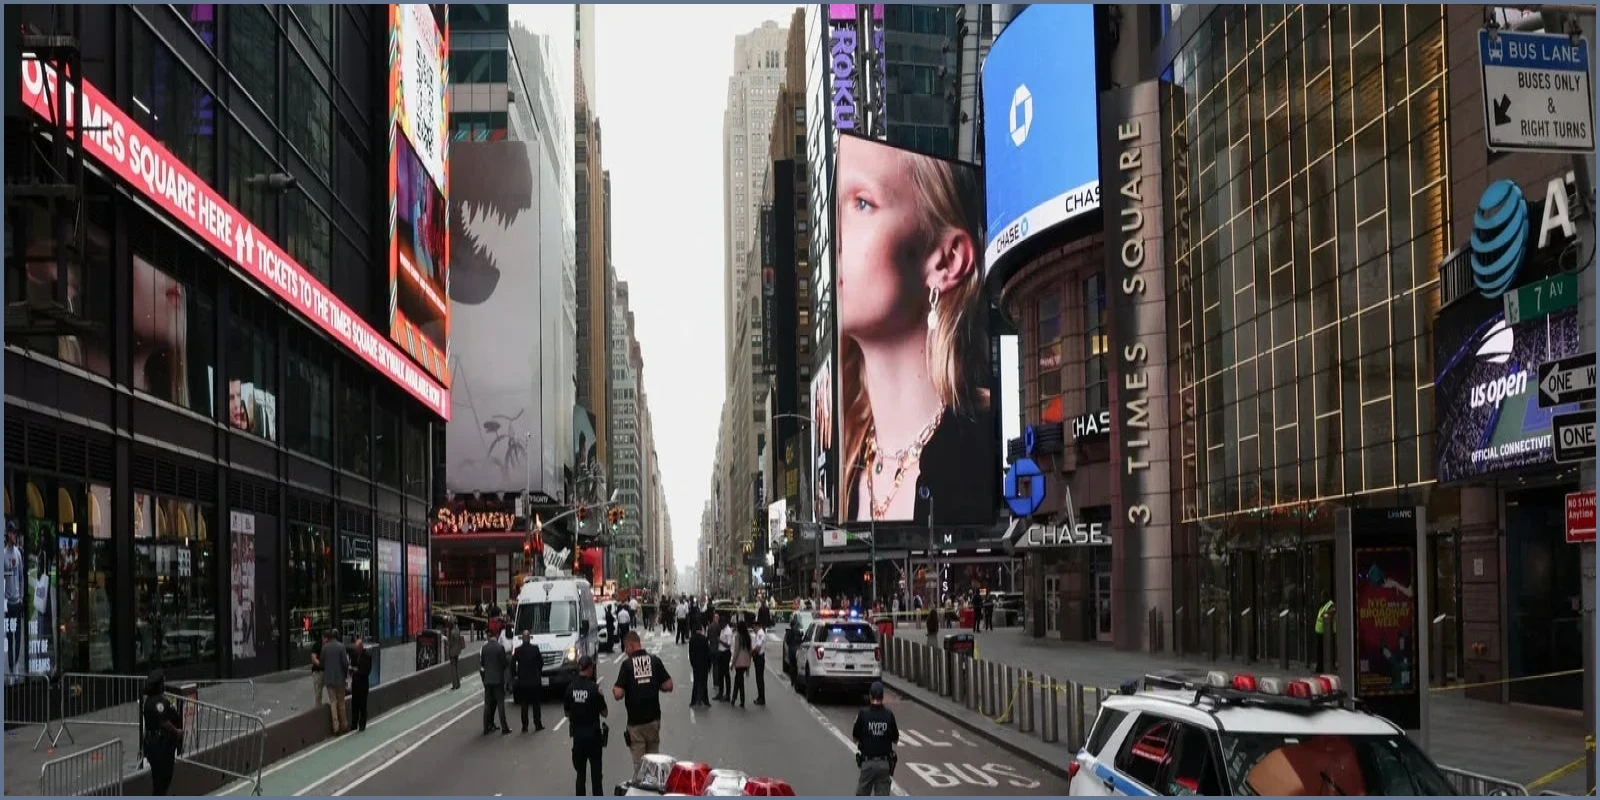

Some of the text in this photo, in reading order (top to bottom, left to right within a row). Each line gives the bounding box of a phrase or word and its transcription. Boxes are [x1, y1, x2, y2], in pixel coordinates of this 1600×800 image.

[1509, 41, 1581, 63] BUS LANE
[831, 30, 857, 129] ROKU
[1518, 72, 1580, 92] BUSES ONLY
[1547, 97, 1556, 114] &
[1521, 120, 1586, 139] RIGHT TURNS
[66, 81, 125, 163] TMES
[129, 134, 196, 220] SQUARE
[198, 190, 233, 248] HERE
[256, 239, 299, 299] TICKETS
[299, 274, 312, 309] TO
[312, 287, 329, 323] THE
[329, 301, 352, 340] TIMES
[352, 320, 379, 363] SQUARE
[996, 223, 1020, 254] CHASE
[1534, 281, 1563, 313] 7 AV
[1118, 120, 1151, 524] 3 TIMES SQUARE
[1549, 372, 1573, 393] ONE
[1564, 425, 1596, 445] ONE
[1471, 447, 1499, 463] OFFICIAL
[1568, 499, 1577, 508] NO
[438, 507, 515, 531] Subway
[1569, 509, 1594, 521] Anytime
[1027, 522, 1103, 546] CHASE
[632, 655, 651, 666] NYPD
[573, 690, 588, 699] NYPD
[868, 721, 888, 731] NYPD
[904, 762, 1040, 789] BUS
